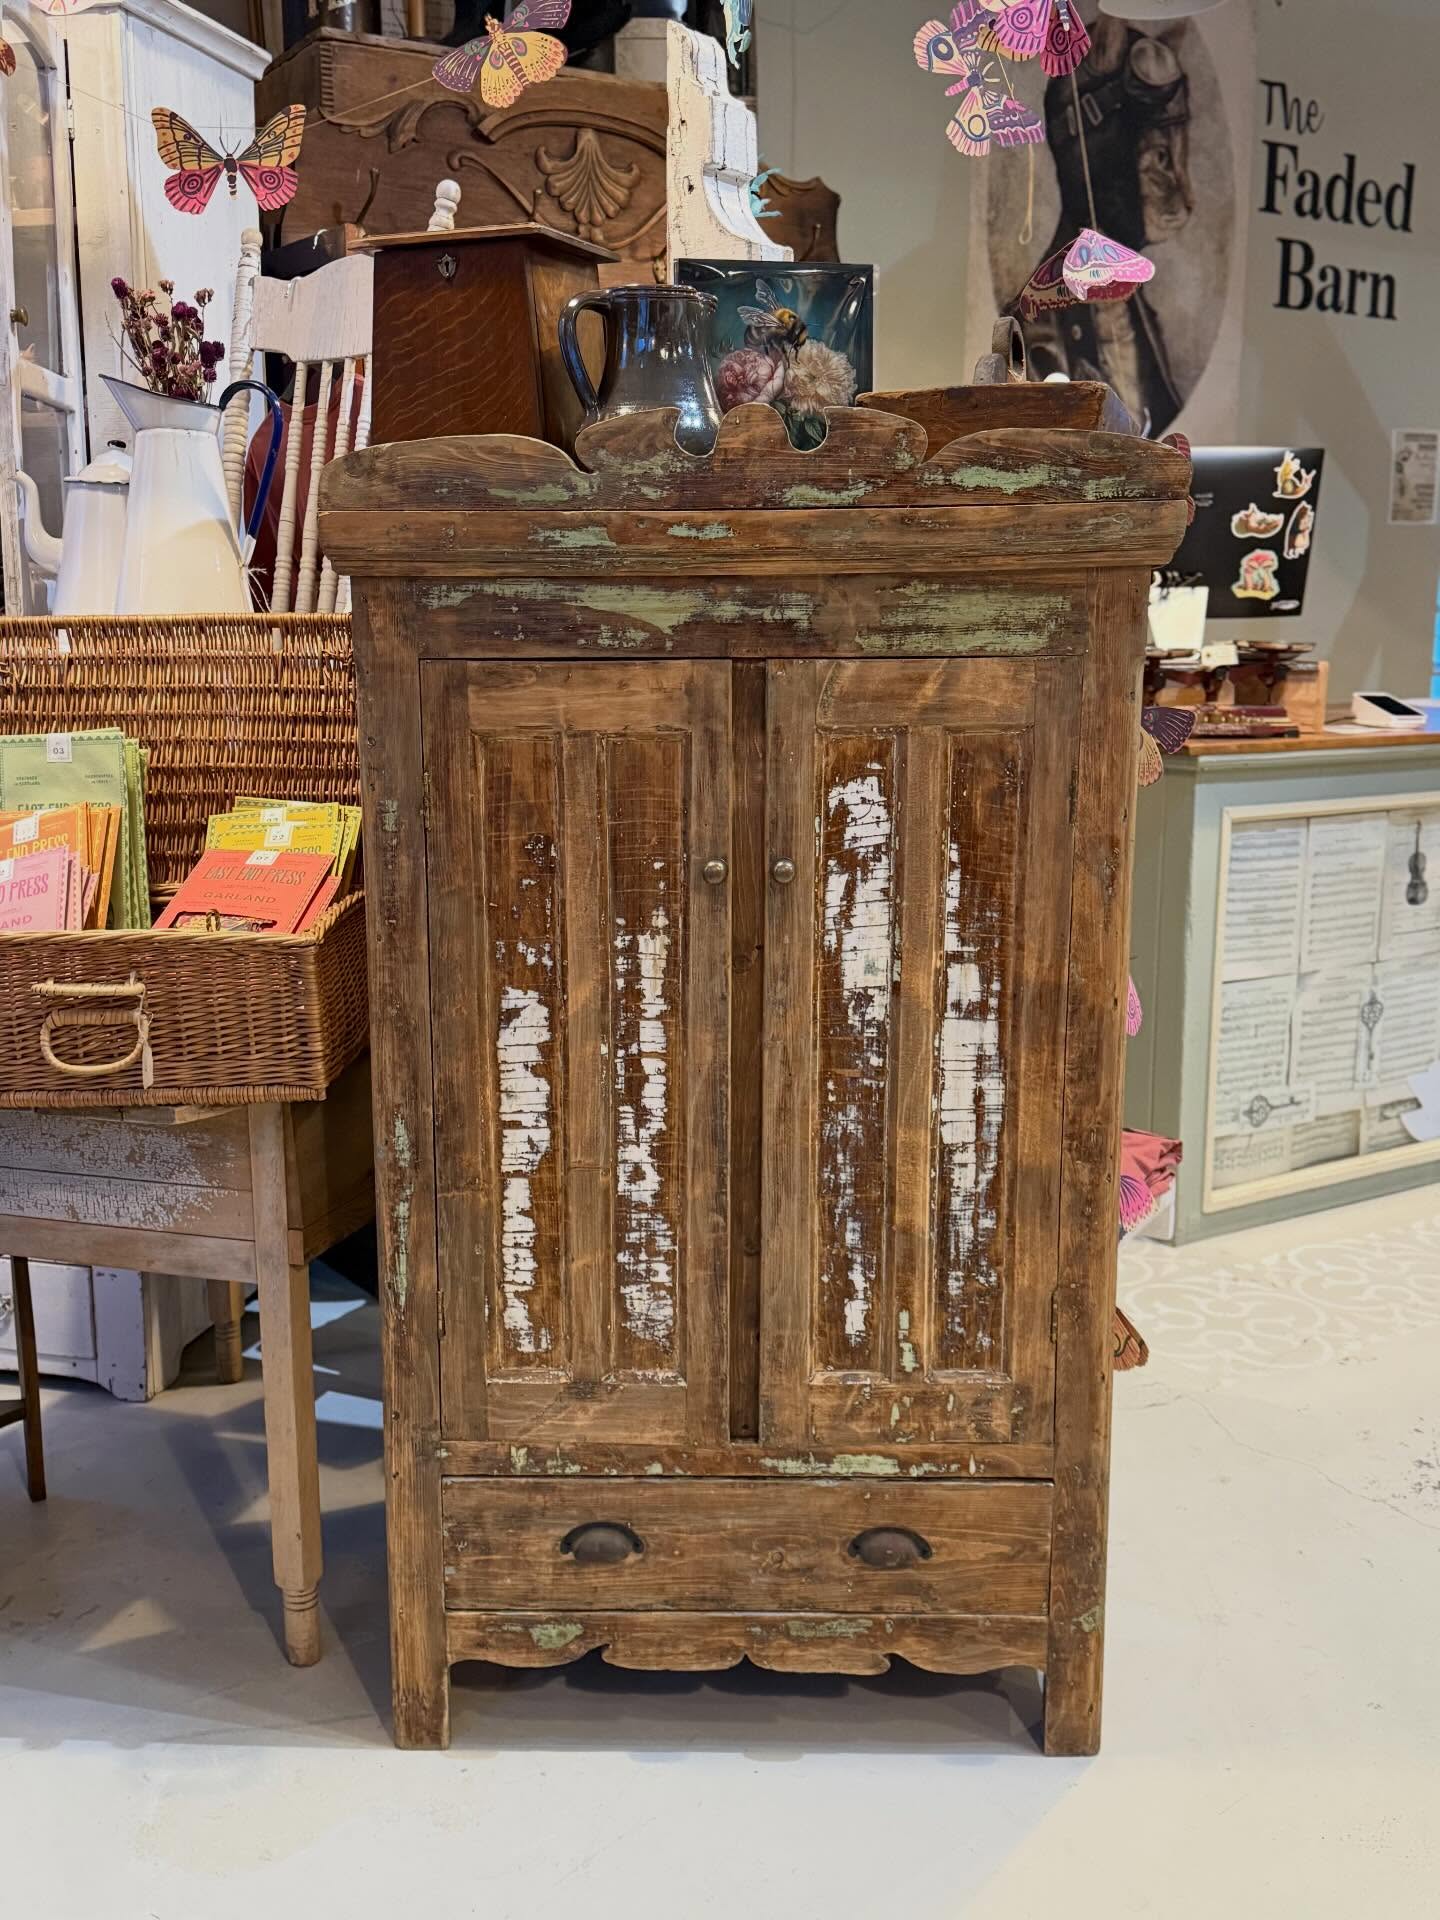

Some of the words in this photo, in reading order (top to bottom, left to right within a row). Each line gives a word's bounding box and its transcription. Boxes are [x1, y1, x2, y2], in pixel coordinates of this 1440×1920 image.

[1259, 79, 1325, 135] The
[1258, 139, 1416, 233] Faded
[1273, 237, 1397, 321] Barn
[9, 873, 49, 901] PRESS
[202, 864, 237, 881] EAST
[236, 866, 264, 883] END
[263, 866, 306, 886] PRESS
[203, 891, 277, 904] GARLAND
